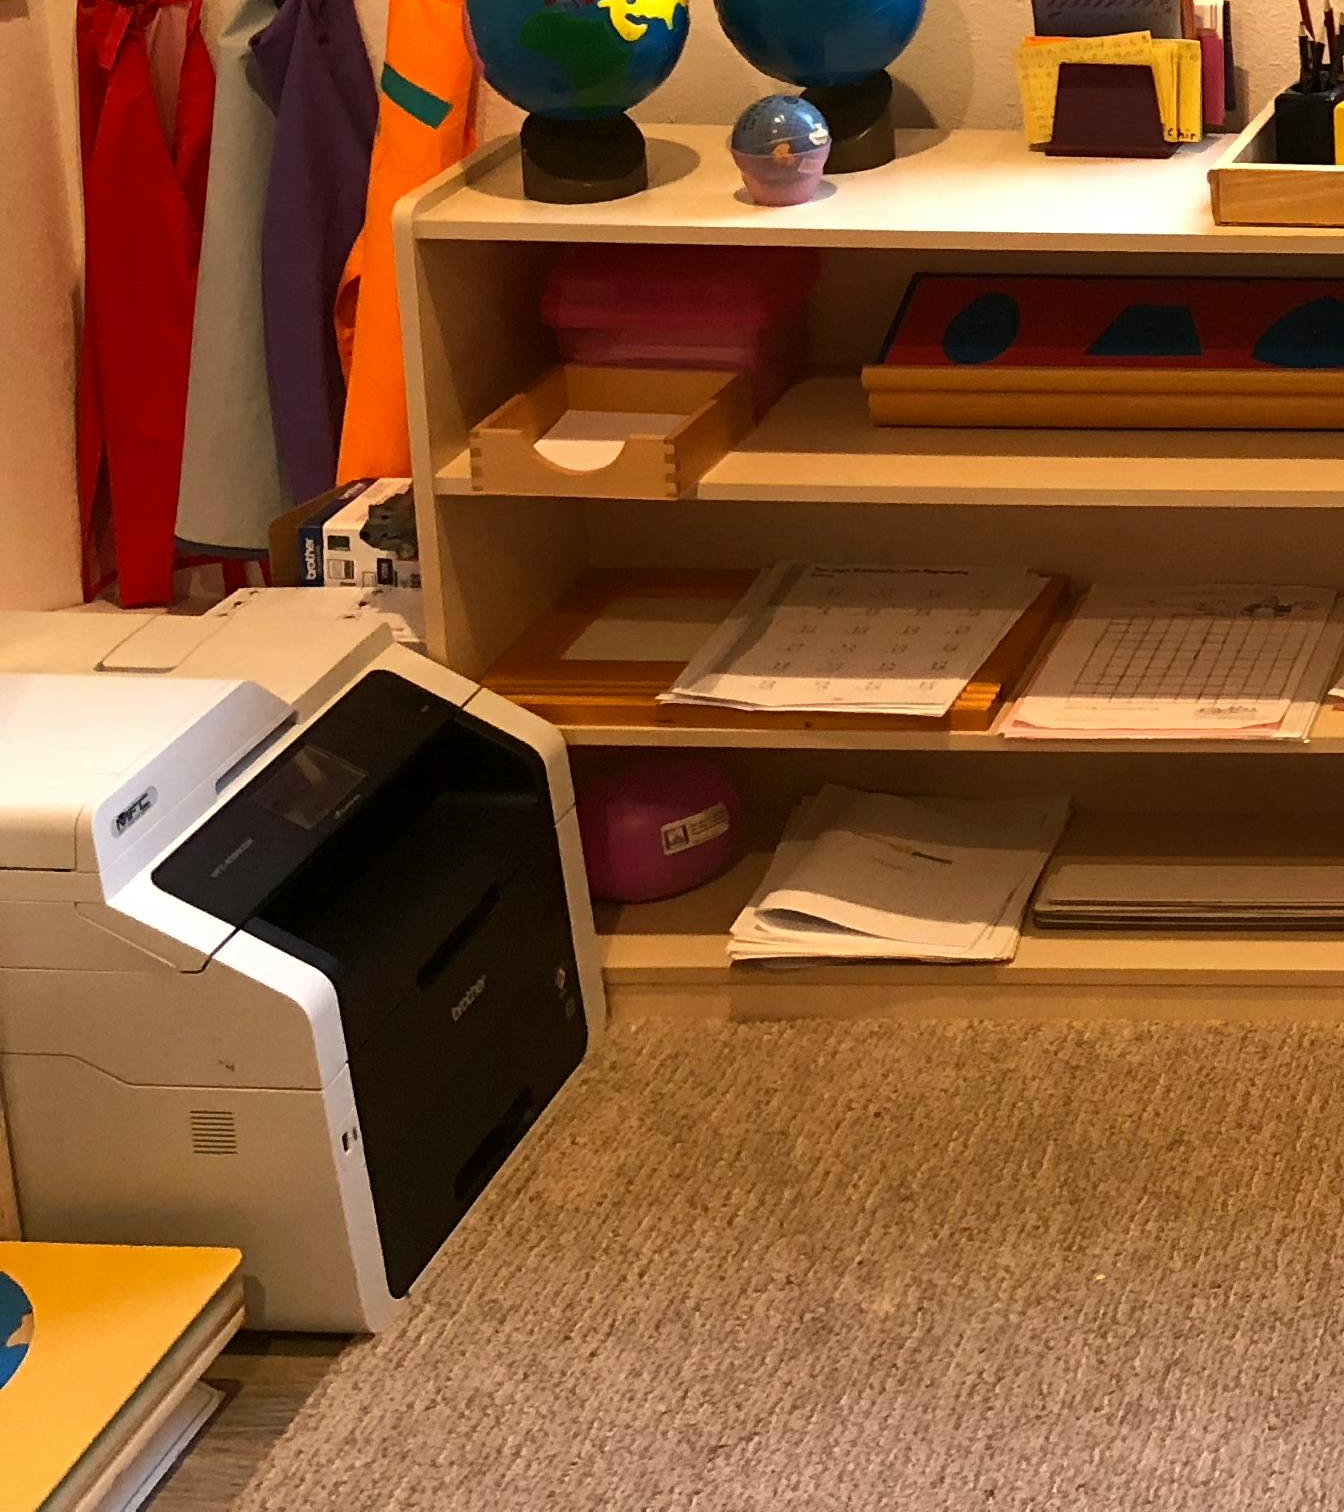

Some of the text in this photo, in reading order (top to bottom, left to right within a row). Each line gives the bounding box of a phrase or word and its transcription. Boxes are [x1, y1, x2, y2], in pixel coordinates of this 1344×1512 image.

[304, 538, 317, 580] brother
[116, 793, 151, 831] MFC
[450, 973, 487, 1023] brother
